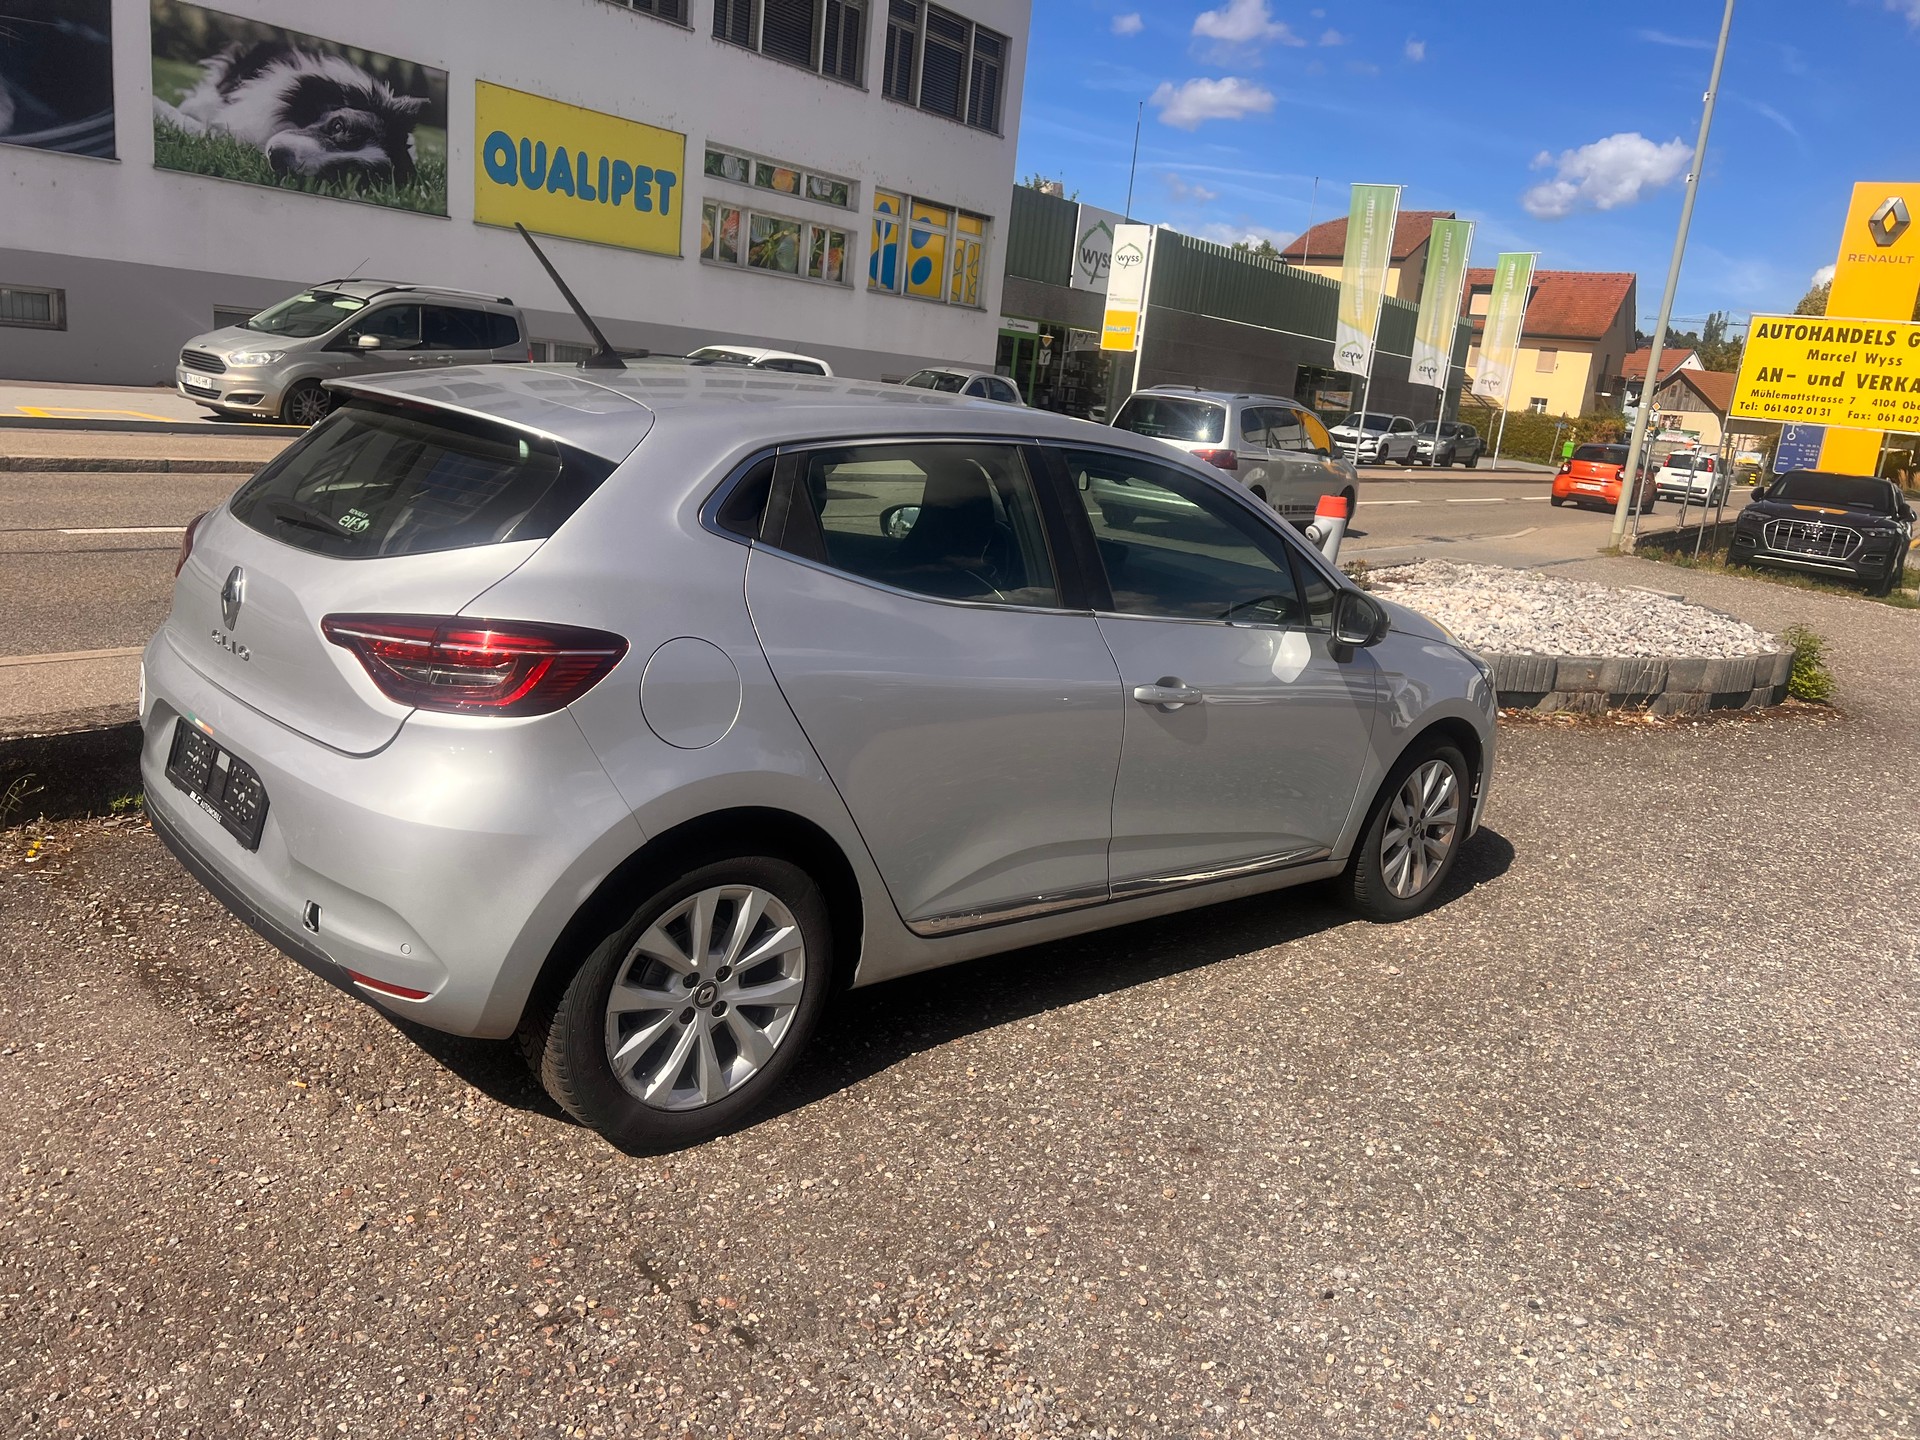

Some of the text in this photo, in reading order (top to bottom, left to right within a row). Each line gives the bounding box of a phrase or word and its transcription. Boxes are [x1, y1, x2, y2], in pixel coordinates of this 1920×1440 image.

[483, 130, 677, 216] QUALIPET
[1117, 254, 1140, 269] wyss
[1848, 253, 1915, 264] RENAULT
[1756, 323, 1897, 346] AUTOHANDELS
[1806, 349, 1903, 367] Marcel Wyss
[1807, 371, 1845, 387] und
[1750, 388, 1844, 404] Mühlemattstrasse
[1849, 396, 1856, 405] 7
[1872, 398, 1897, 408] 4104
[1740, 401, 1758, 411] Tel:
[1847, 410, 1871, 421] Fax:
[338, 515, 361, 528] elf
[211, 629, 250, 662] CLIO
